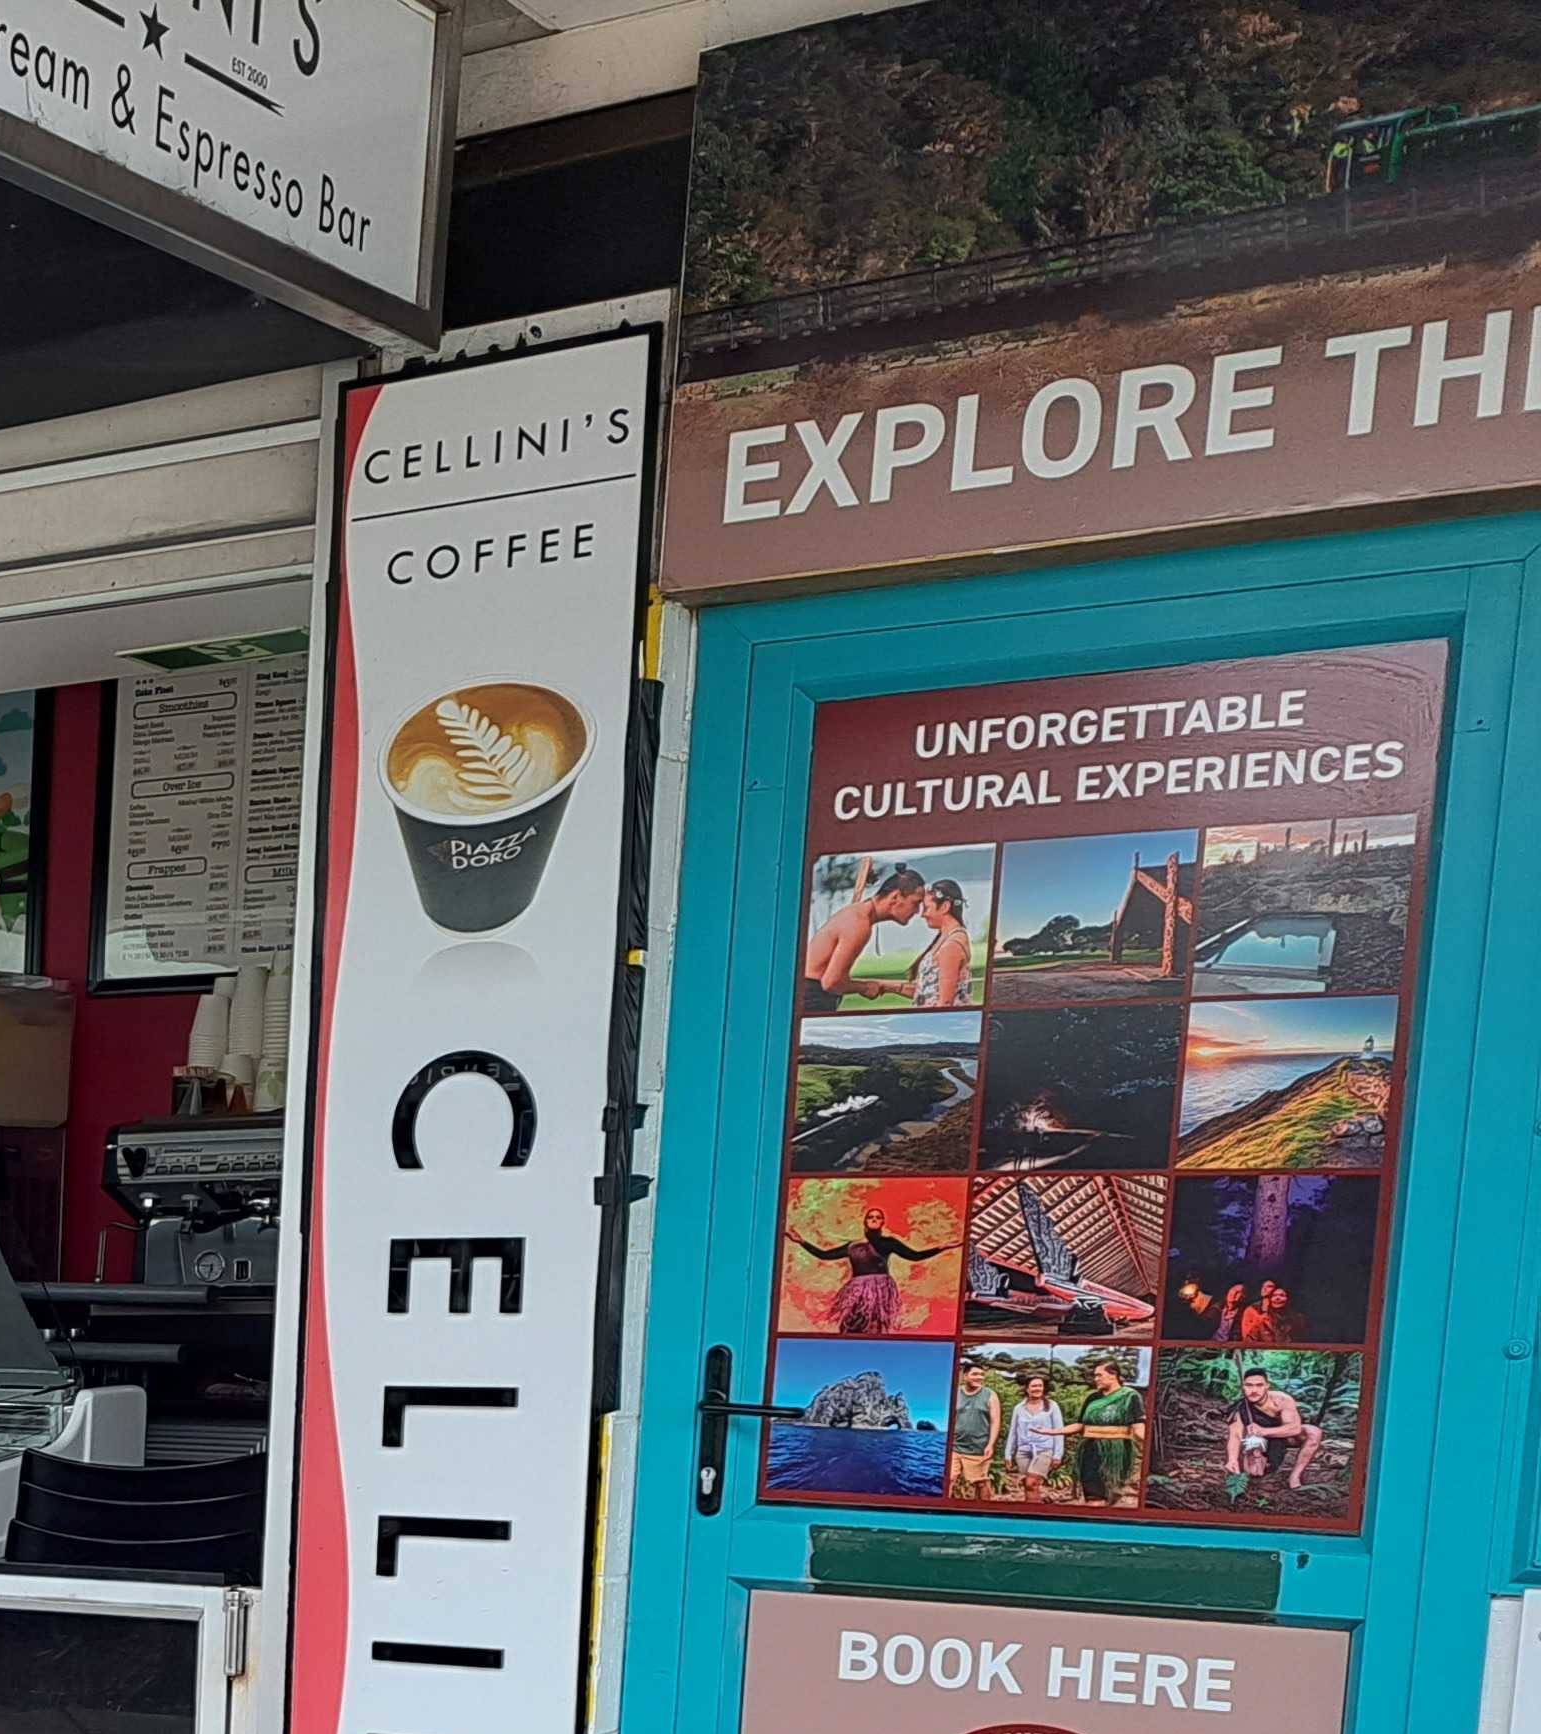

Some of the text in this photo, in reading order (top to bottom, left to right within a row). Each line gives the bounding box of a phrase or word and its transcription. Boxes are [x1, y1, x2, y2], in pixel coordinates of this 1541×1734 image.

[230, 56, 269, 90] EST 2000
[111, 63, 136, 136] &
[155, 86, 303, 219] Espresso
[319, 174, 372, 253] Bar
[362, 405, 633, 487] CELLINI'S
[720, 304, 1541, 526] EXPLORE TH
[385, 521, 597, 586] COFFEE
[914, 687, 1307, 760] UNFORGETTABLE
[831, 739, 1406, 823] CULTURAL EXPERIENCES
[450, 826, 537, 856] PIAZZA
[452, 845, 522, 870] DORO
[837, 1628, 1237, 1714] BOOK HERE
